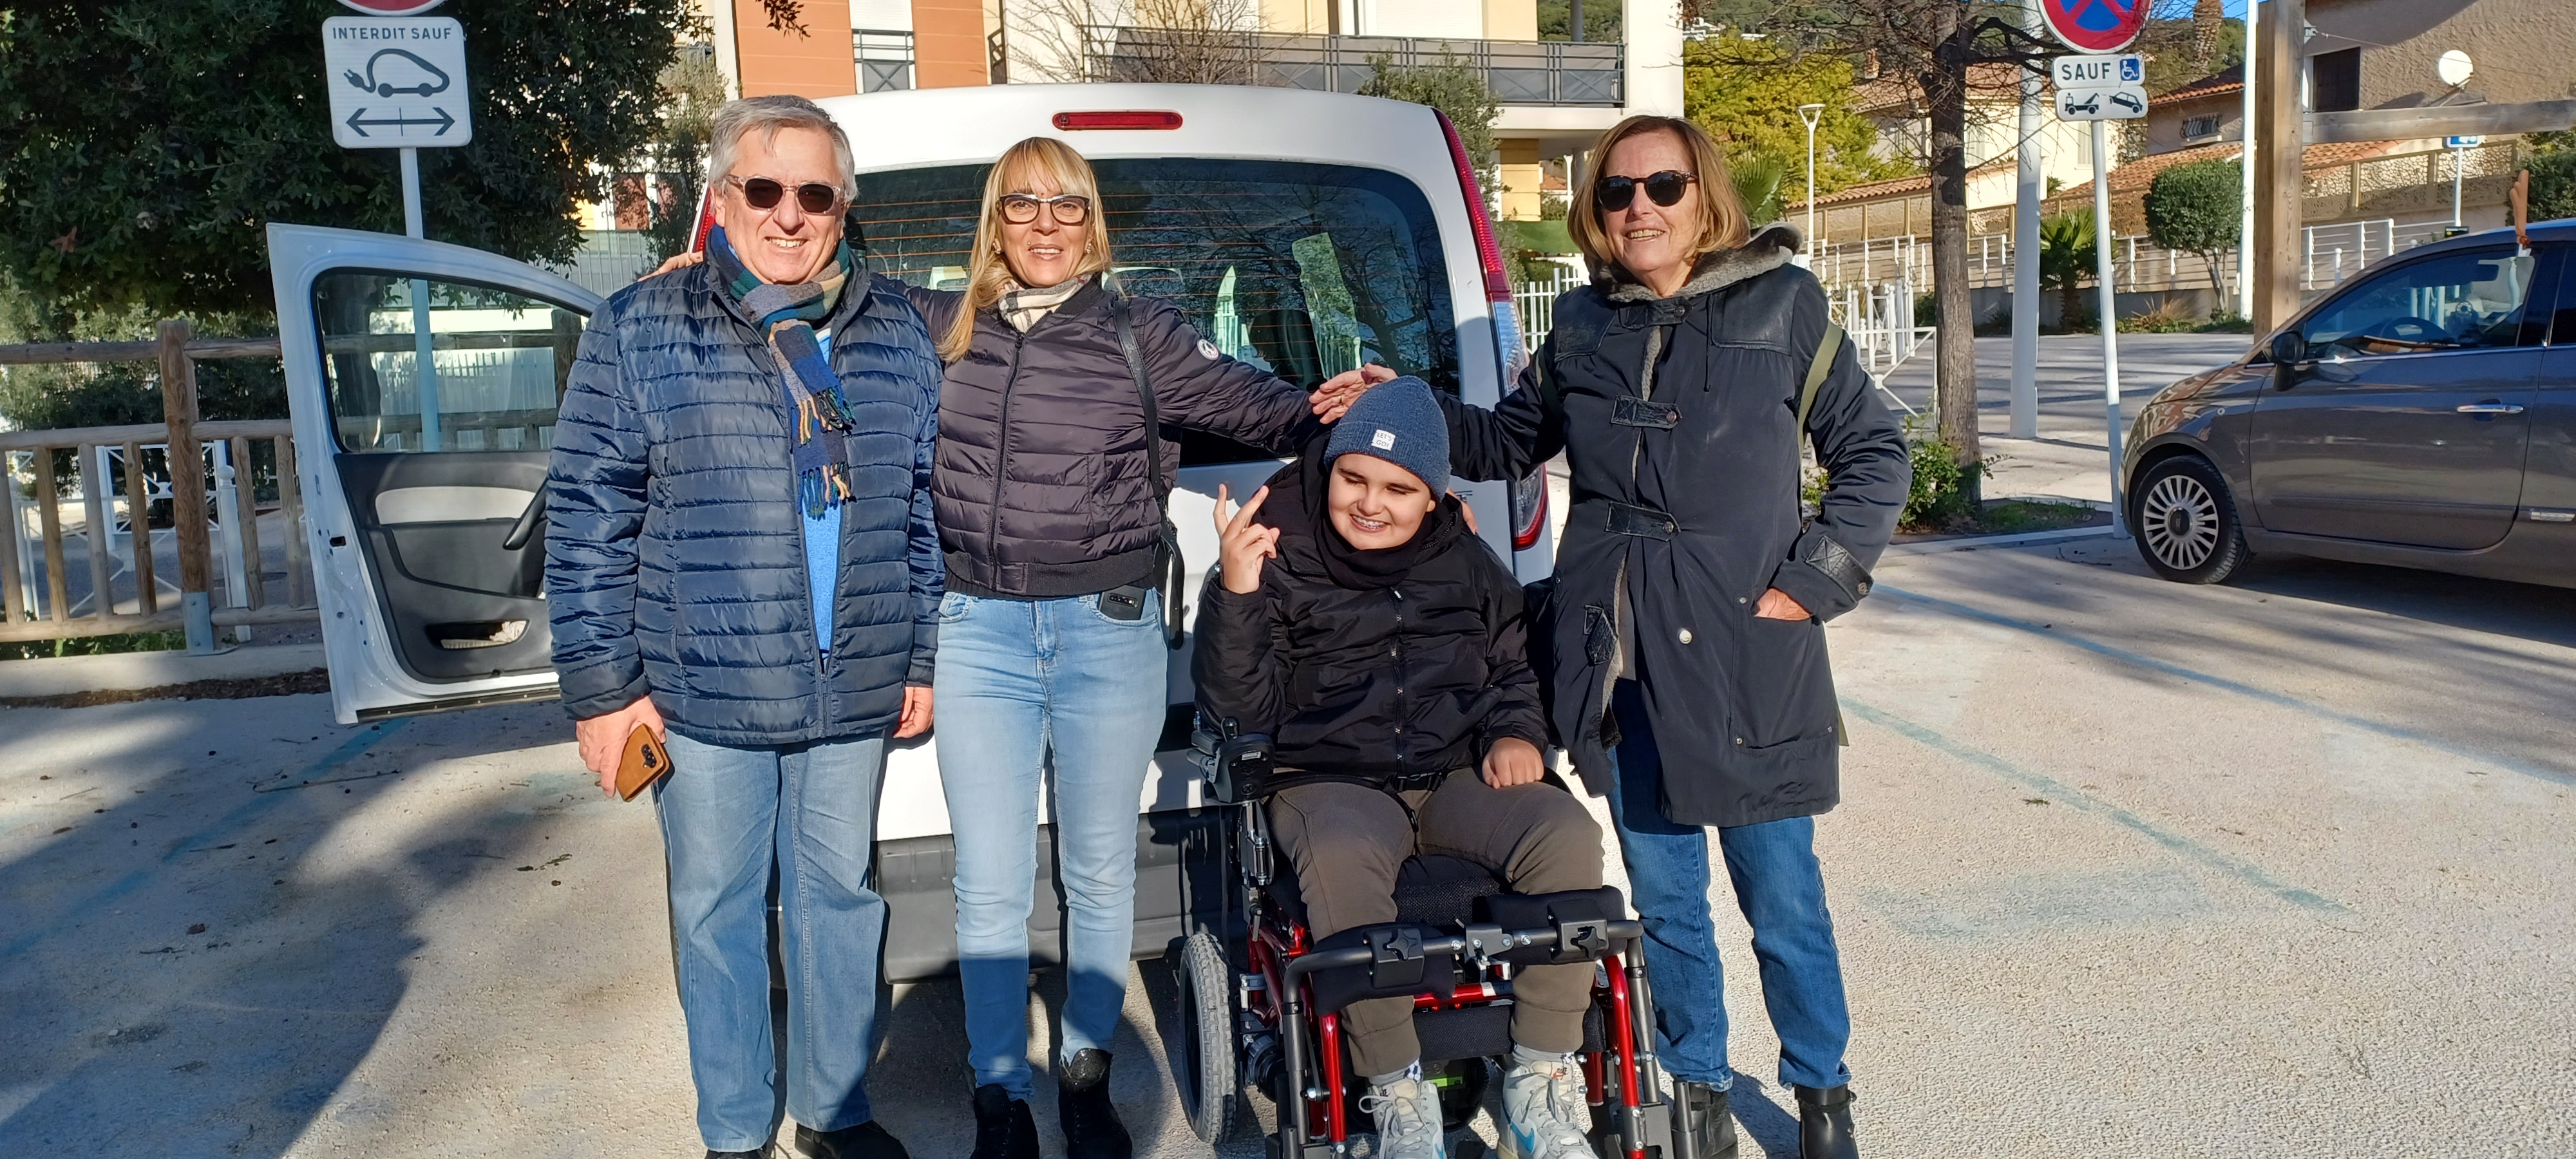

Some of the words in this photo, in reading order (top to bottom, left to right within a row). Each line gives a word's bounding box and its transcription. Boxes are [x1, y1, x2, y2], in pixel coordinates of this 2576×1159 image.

[332, 27, 406, 39] INTERDIT
[412, 27, 452, 39] SAUF
[2061, 62, 2111, 80] SAUF
[1377, 432, 1392, 442] LET'S
